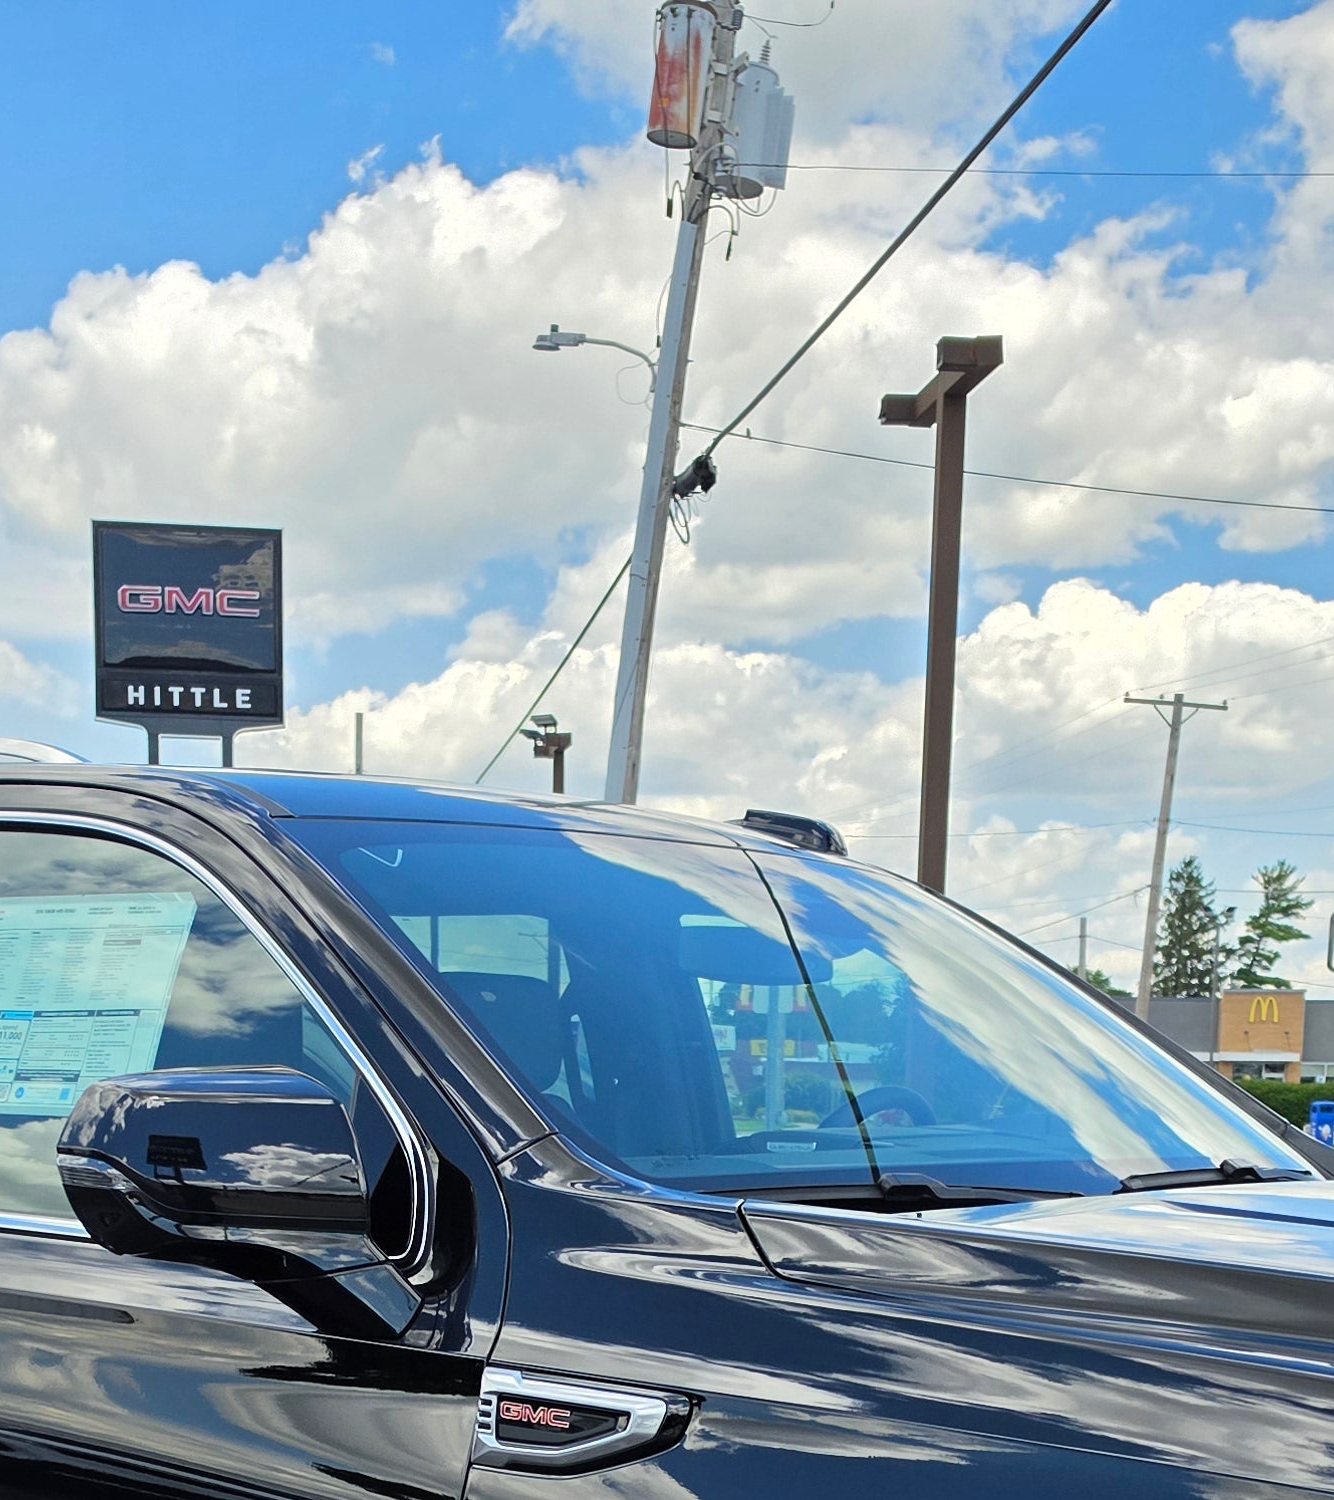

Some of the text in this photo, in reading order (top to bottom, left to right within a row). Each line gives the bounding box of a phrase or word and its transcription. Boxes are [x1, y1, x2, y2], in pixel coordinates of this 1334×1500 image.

[117, 584, 260, 617] GMC
[127, 685, 252, 709] HITTLE
[500, 1401, 571, 1428] GMC
